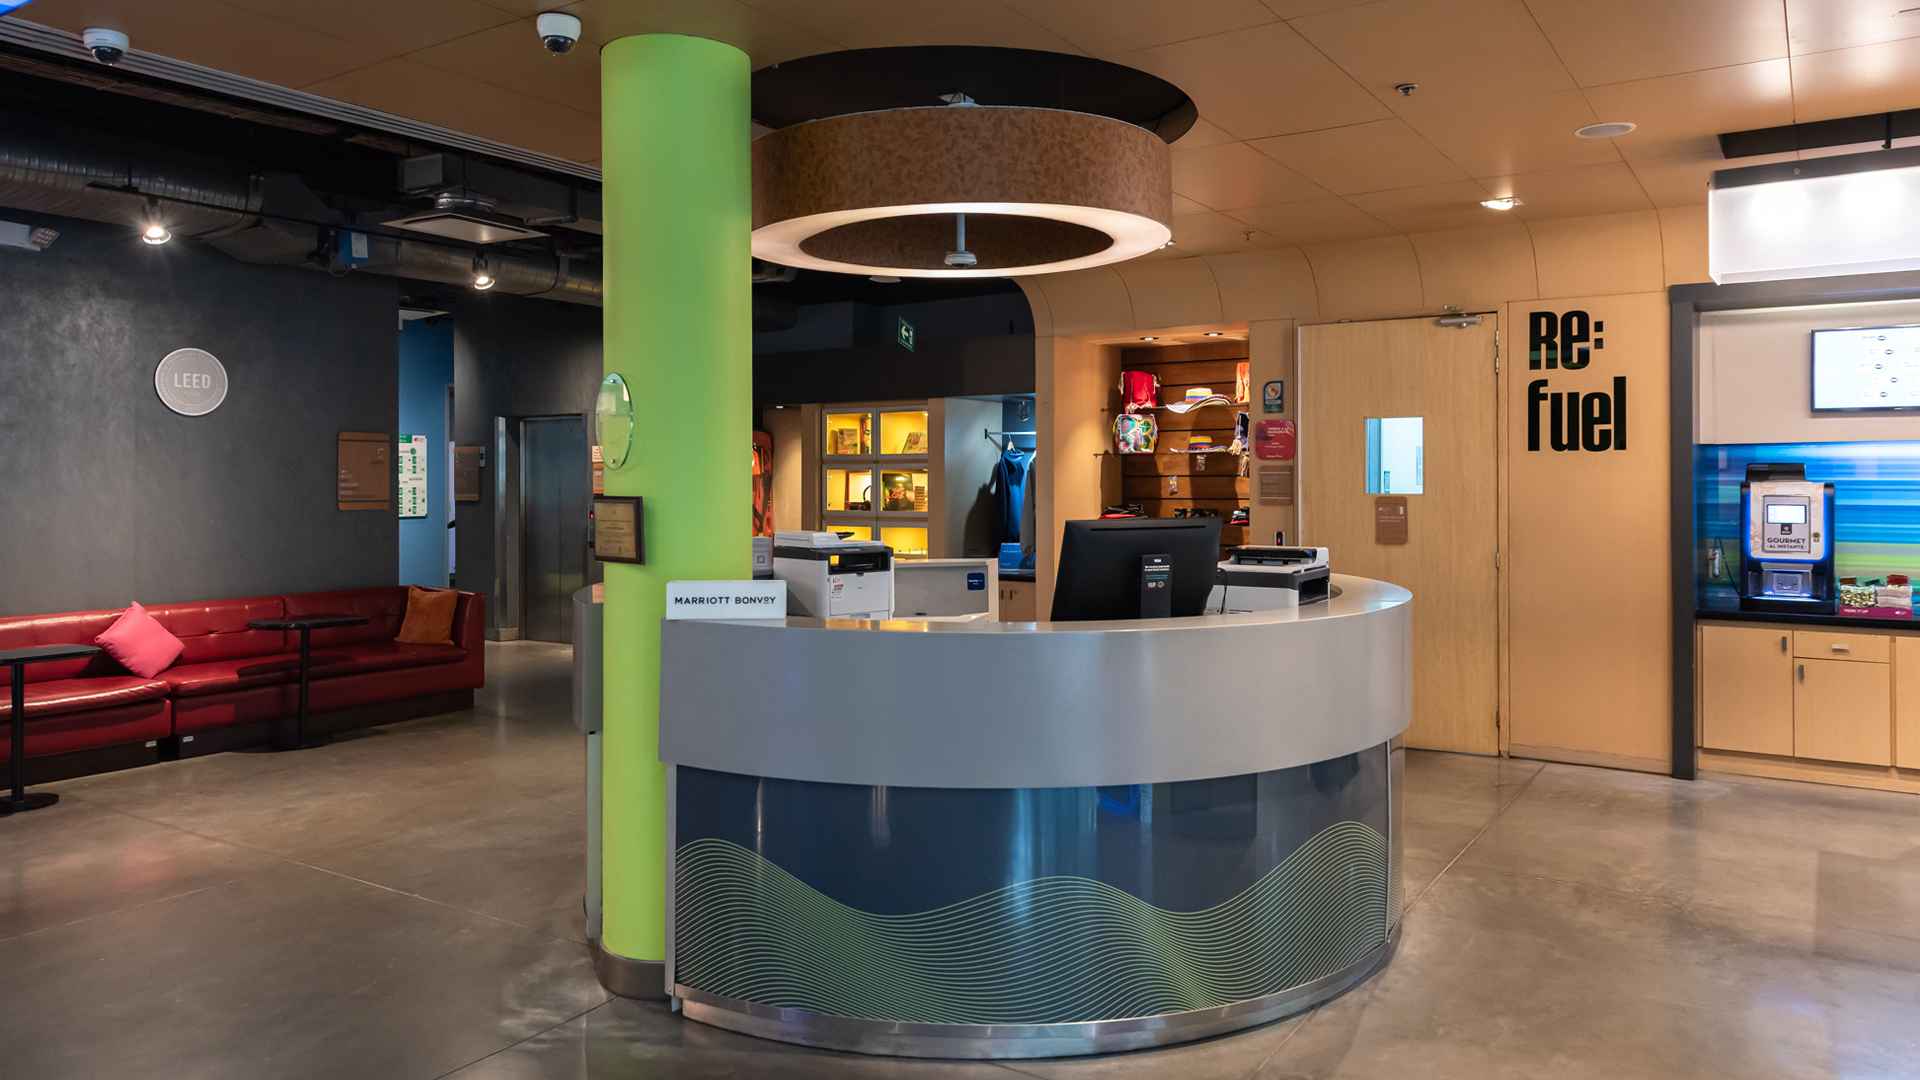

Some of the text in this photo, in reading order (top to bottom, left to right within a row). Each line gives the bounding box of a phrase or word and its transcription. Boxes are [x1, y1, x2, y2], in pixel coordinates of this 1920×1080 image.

[174, 372, 211, 389] LEED
[1527, 376, 1627, 452] fuel
[674, 596, 776, 605] MARRIOTT BONVOY
